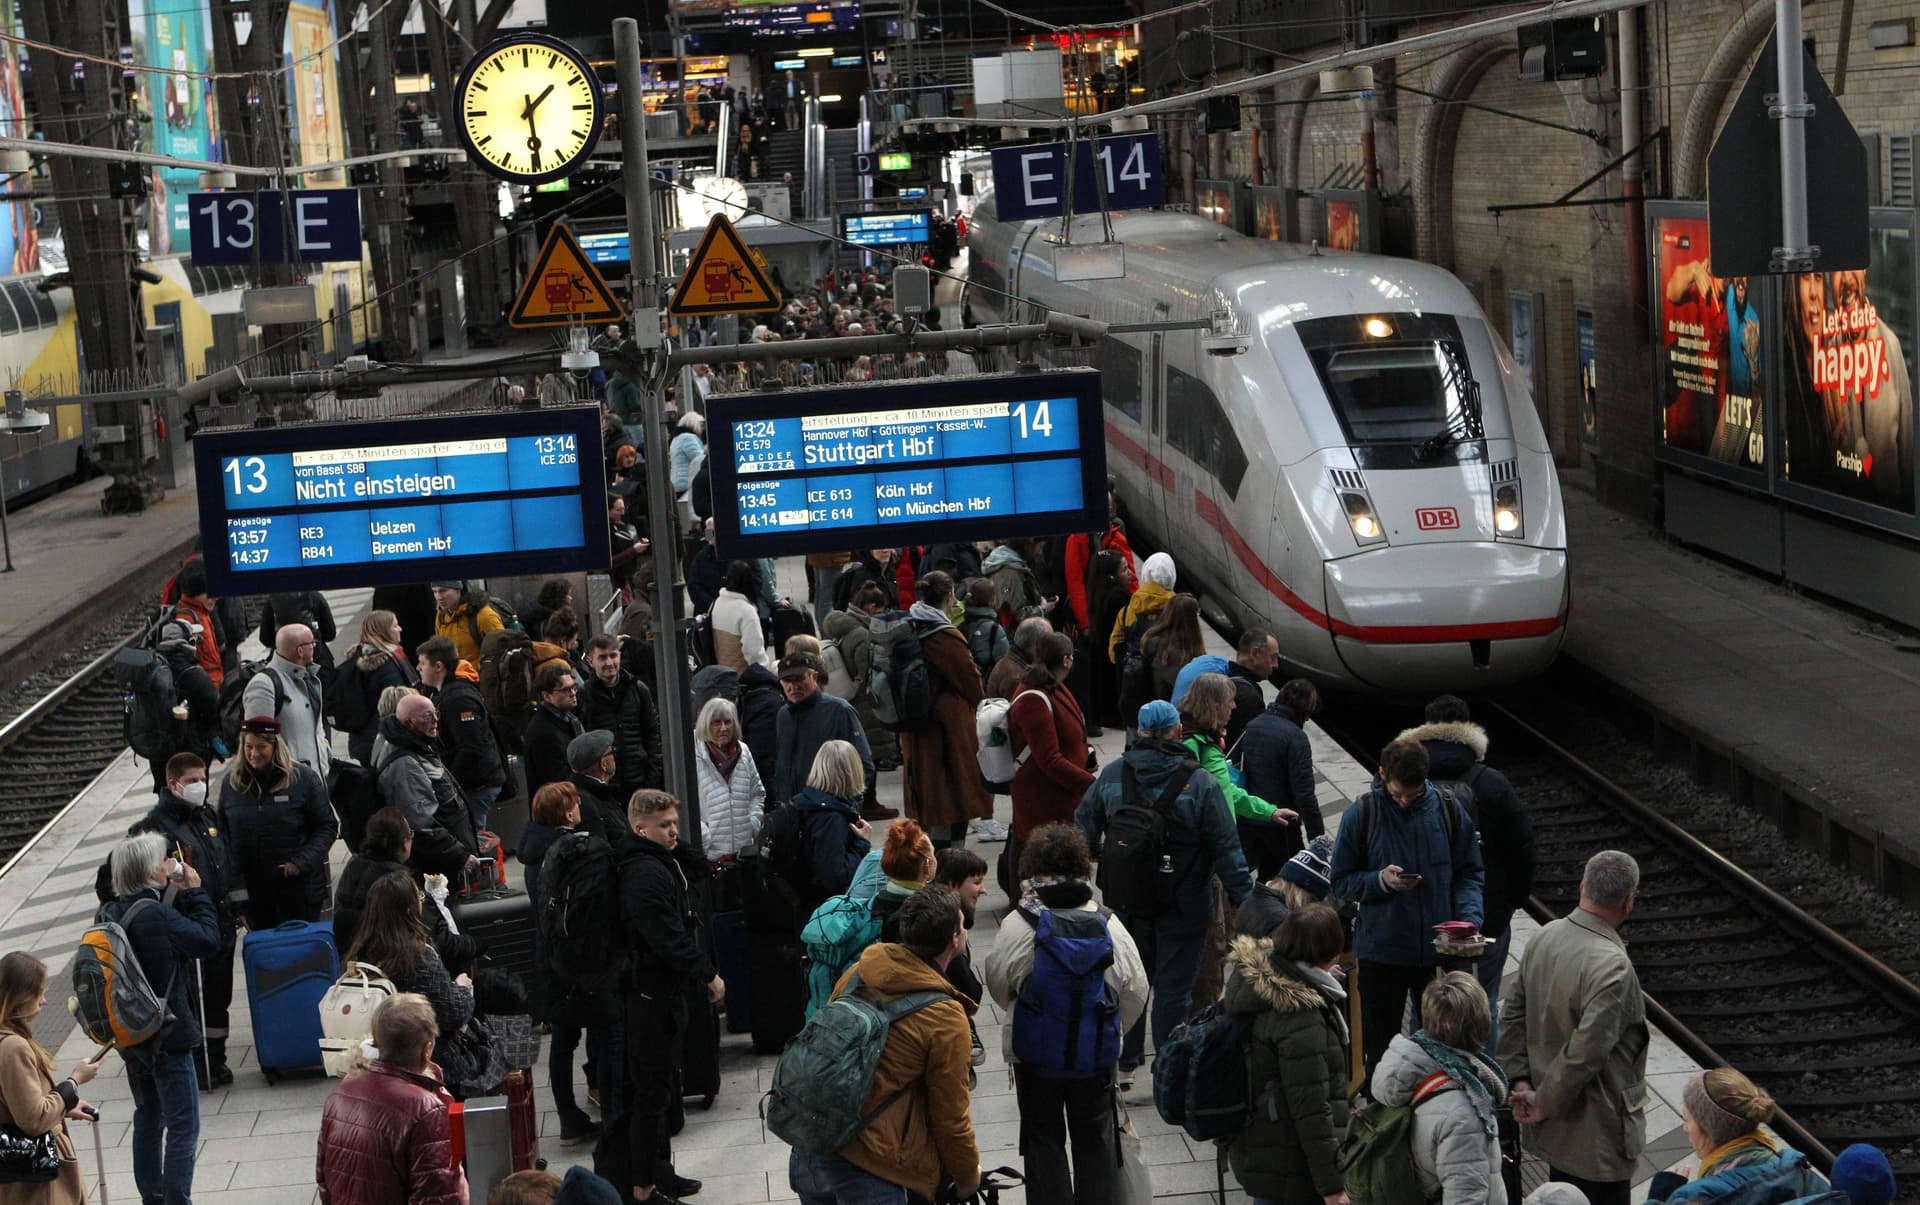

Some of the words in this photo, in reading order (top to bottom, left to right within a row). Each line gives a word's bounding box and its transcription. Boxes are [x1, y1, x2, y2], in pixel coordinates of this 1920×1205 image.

[872, 51, 885, 62] 14
[858, 155, 870, 172] D
[1021, 152, 1058, 206] E
[1097, 142, 1151, 193] 14
[200, 199, 254, 249] 13
[295, 197, 331, 250] E
[912, 214, 921, 224] 14
[1822, 306, 1848, 334] Let's
[1850, 302, 1876, 330] date
[1813, 334, 1888, 397] happy.
[922, 406, 968, 419] Minuten
[1012, 402, 1053, 438] 14
[1725, 393, 1752, 429] LET'S
[736, 422, 776, 439] 13:24
[804, 429, 849, 441] Hannover
[852, 427, 869, 438] Hbf
[880, 424, 927, 436] Göttingen
[936, 420, 986, 432] Kassel-W.
[535, 436, 575, 453] 13:14
[736, 441, 750, 452] ICE
[753, 440, 771, 450] 579
[804, 438, 895, 465] Stuttgart
[902, 436, 934, 456] Hbf
[1748, 432, 1764, 464] GO
[540, 455, 555, 465] ICE
[558, 454, 576, 464] 206
[739, 454, 746, 462] A
[749, 454, 754, 462] B
[768, 452, 774, 460] D
[776, 452, 782, 460] E
[786, 451, 792, 459] F
[1836, 450, 1862, 478] Parship
[224, 457, 268, 495] 13
[296, 468, 314, 477] von
[316, 464, 344, 475] Basel
[347, 464, 365, 474] SBB
[296, 479, 346, 500] Nicht
[354, 474, 456, 496] einsteigen
[737, 480, 780, 491] Folgezüge
[740, 494, 776, 508] 13:45
[808, 490, 826, 503] ICE
[830, 488, 852, 501] 613
[876, 484, 906, 498] Köln
[910, 482, 933, 496] Hbf
[228, 517, 272, 527] Folgezüge
[740, 512, 778, 528] 14:14
[809, 510, 827, 522] ICE
[831, 508, 853, 520] 614
[878, 507, 901, 518] von
[906, 500, 964, 516] München
[968, 496, 991, 510] Hbf
[1420, 510, 1455, 527] DB
[230, 530, 268, 545] 13:57
[300, 527, 324, 540] RE3
[370, 522, 416, 536] Uelzen
[232, 549, 269, 565] 14:37
[302, 546, 333, 559] RB41
[372, 540, 422, 556] Bremen
[428, 536, 452, 550] Hbf
